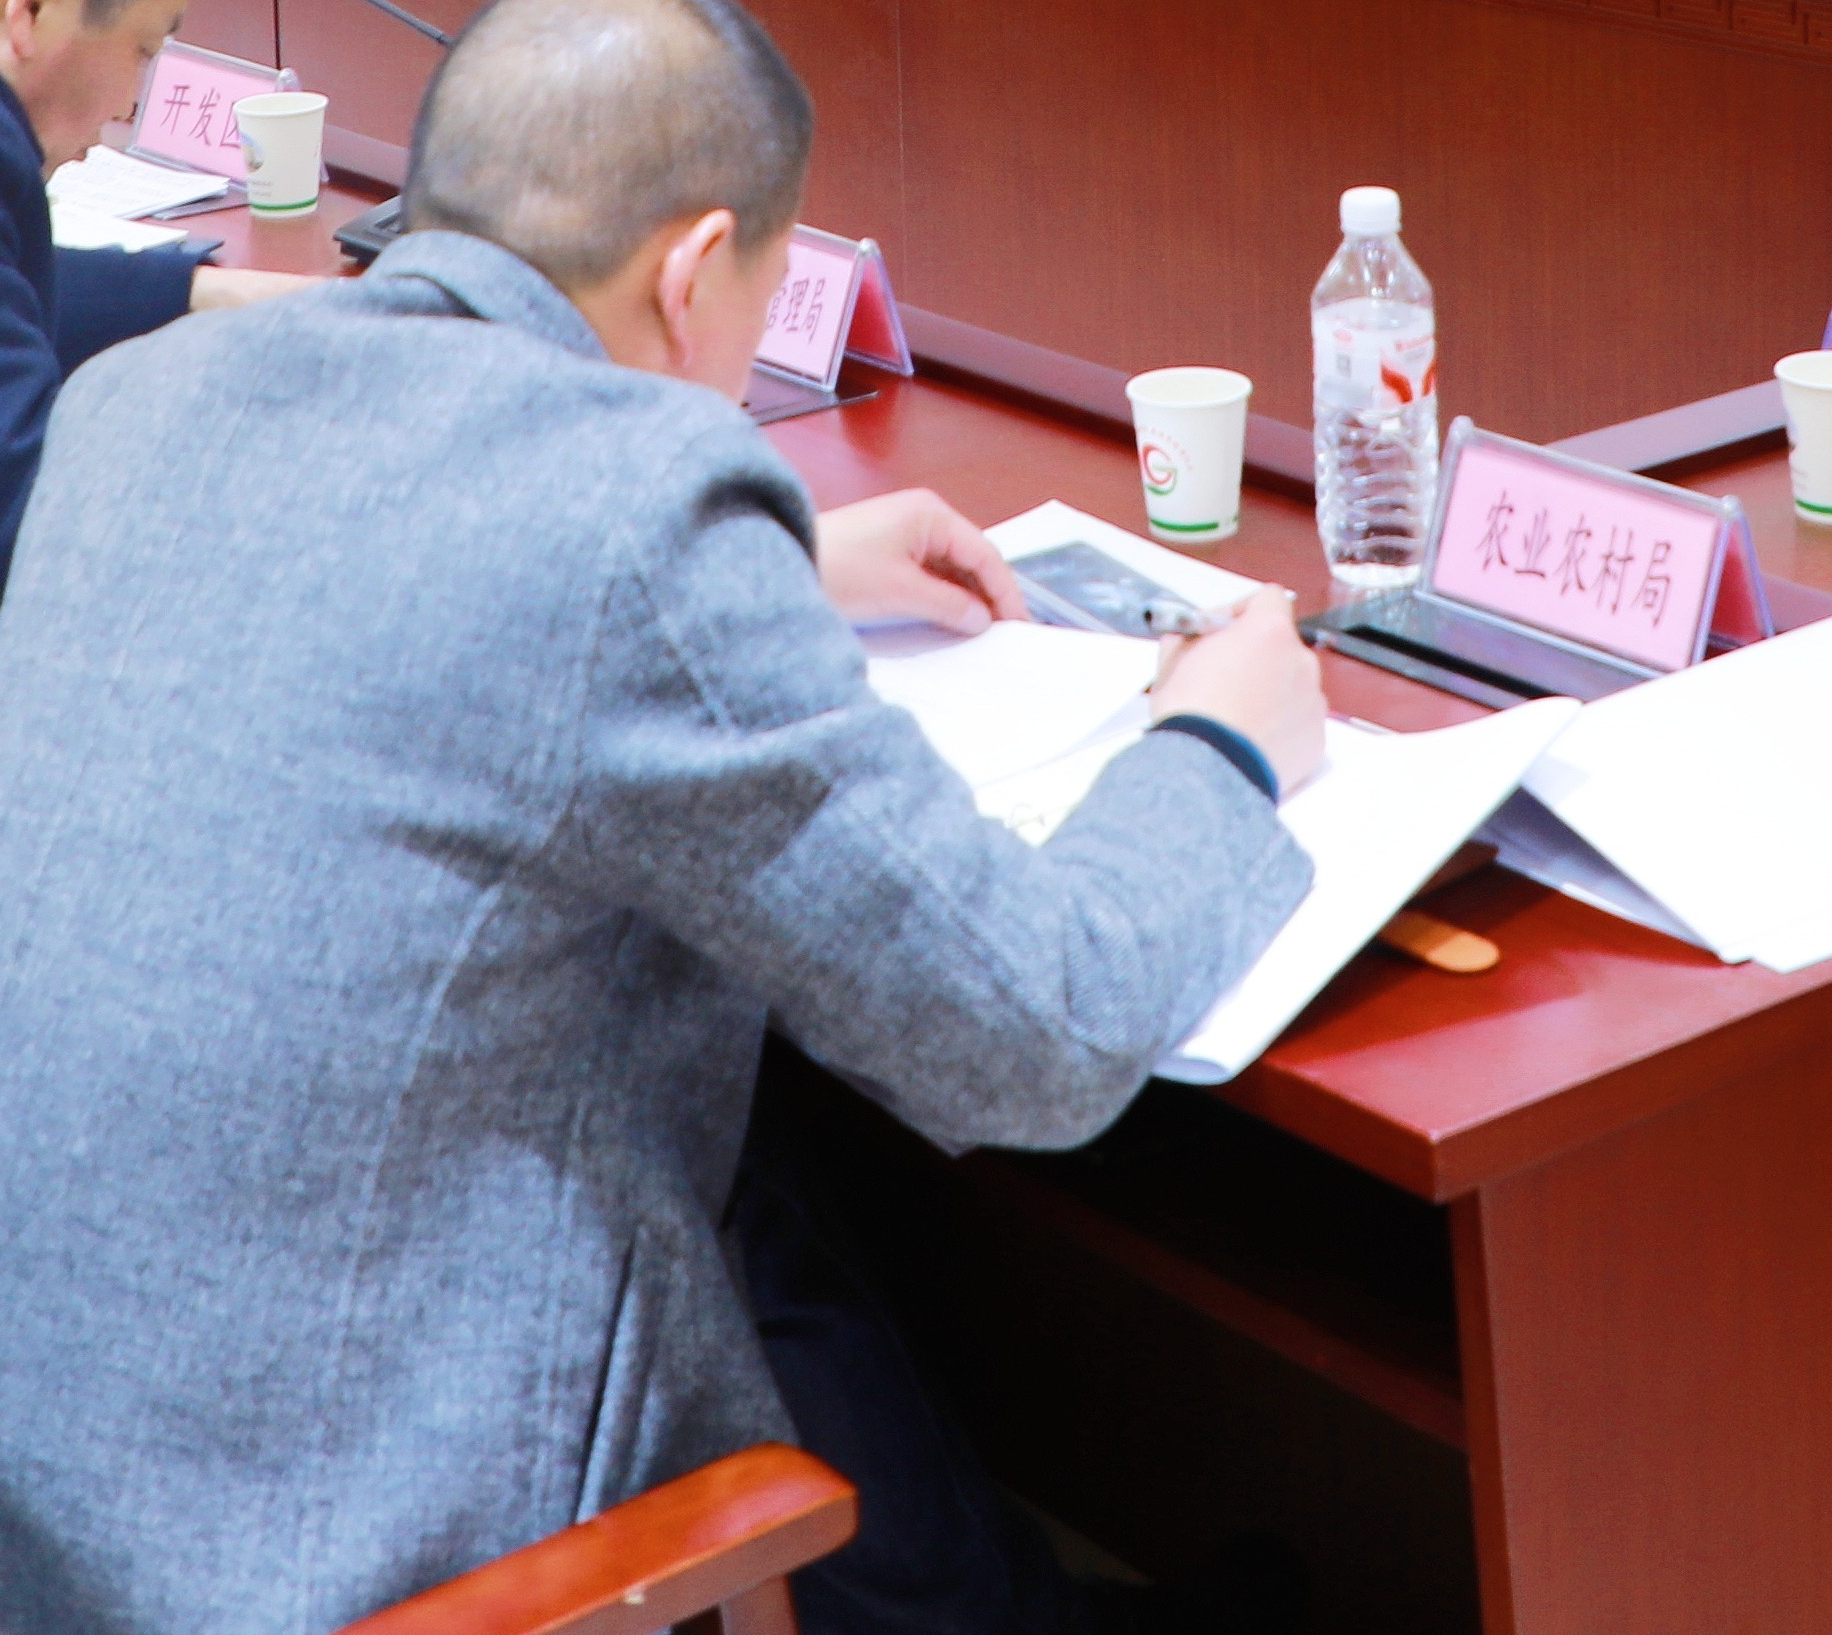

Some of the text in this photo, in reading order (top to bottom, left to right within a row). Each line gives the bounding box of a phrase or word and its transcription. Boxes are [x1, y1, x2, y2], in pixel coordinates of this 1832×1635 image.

[1475, 489, 1673, 628] 农业农村局
